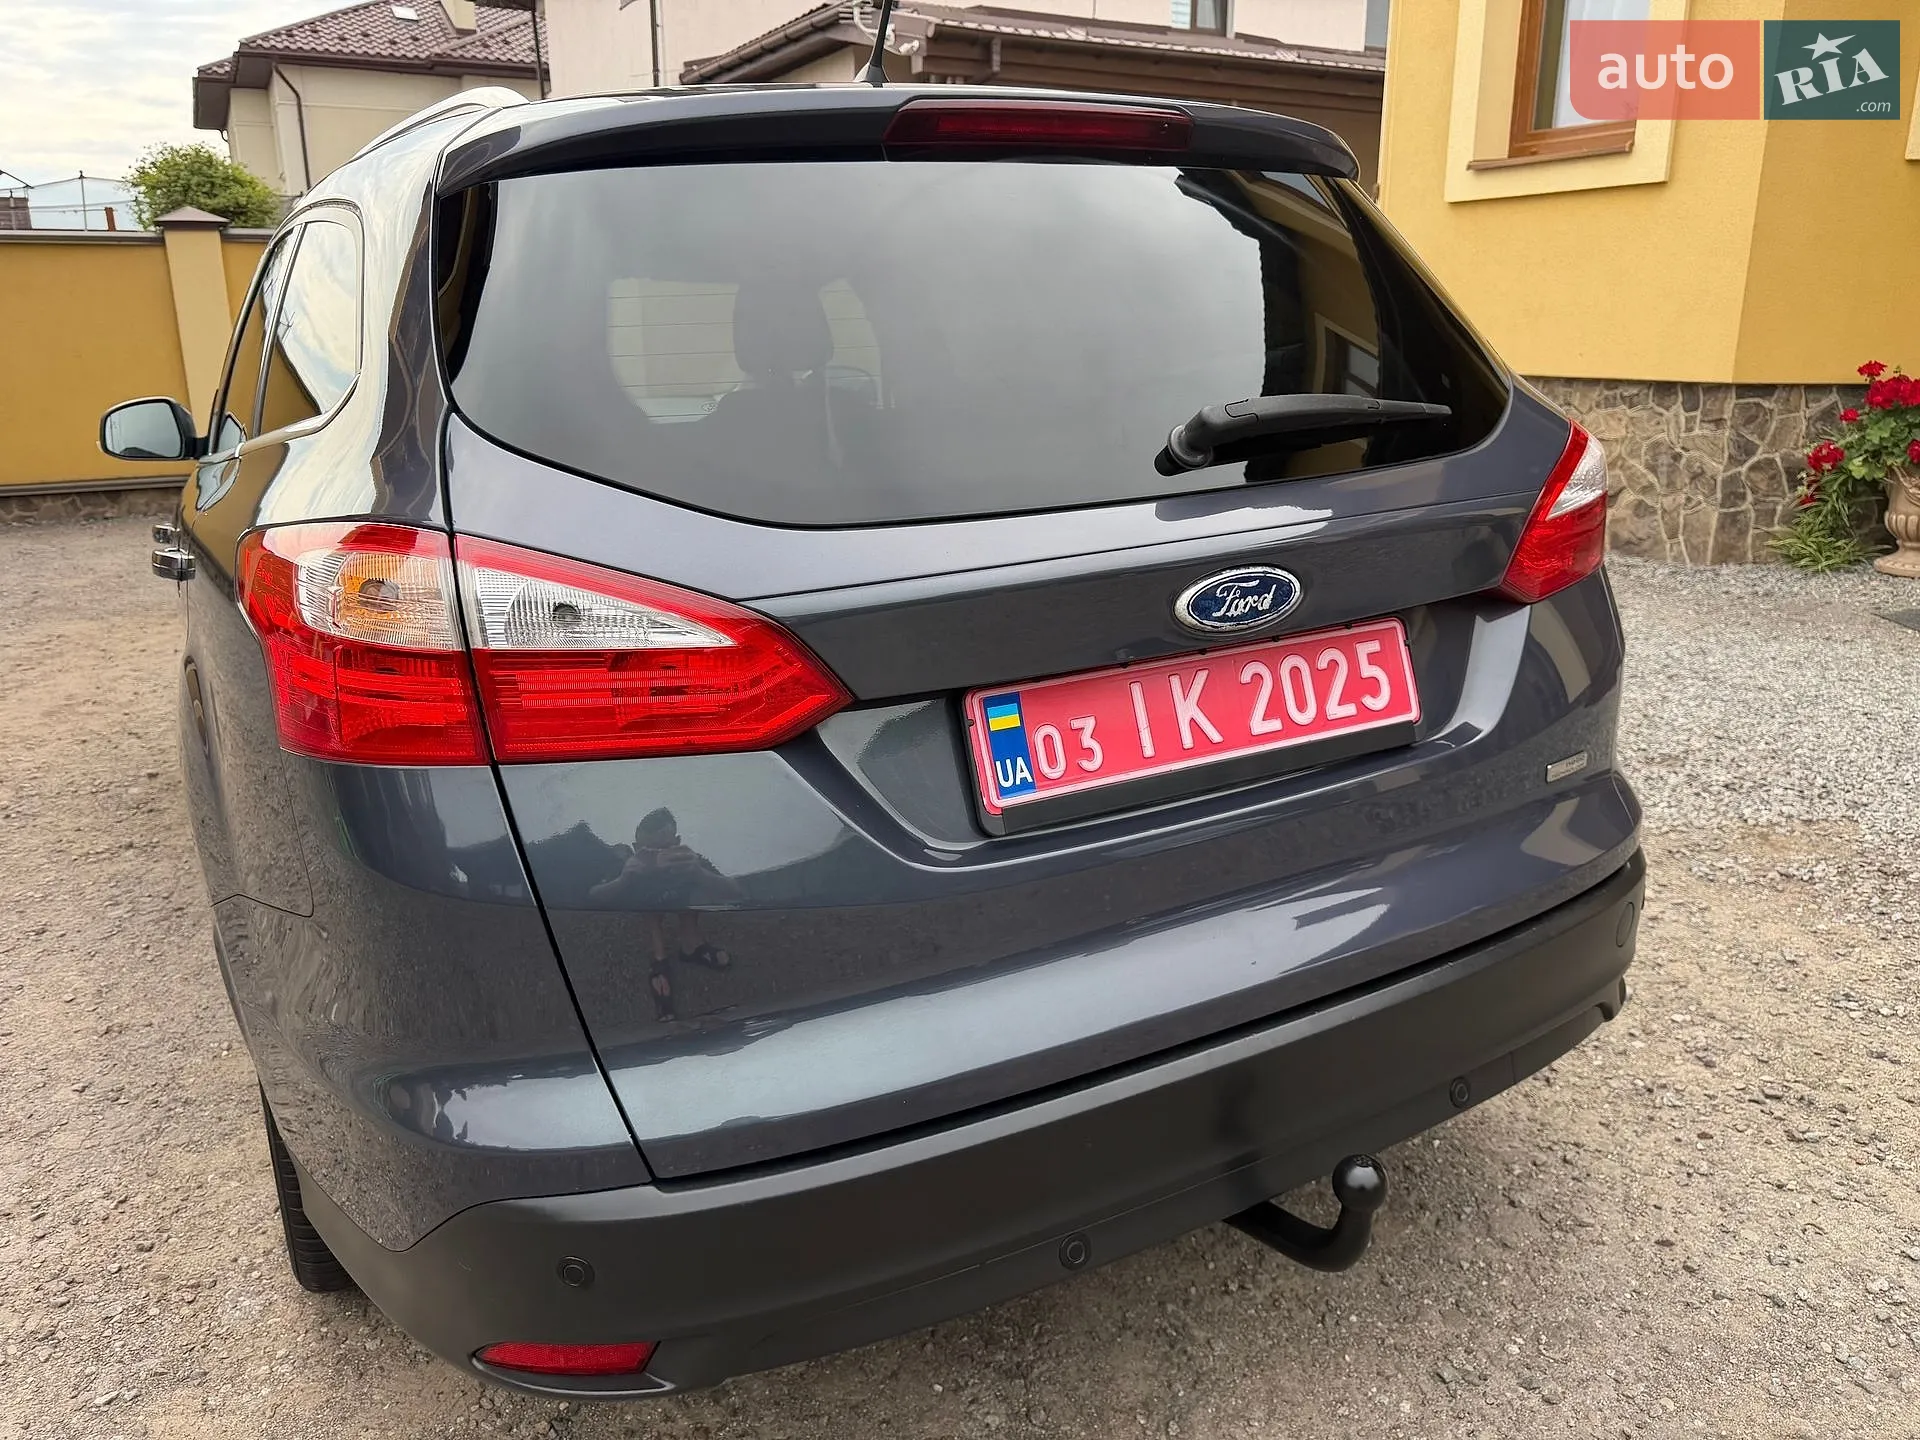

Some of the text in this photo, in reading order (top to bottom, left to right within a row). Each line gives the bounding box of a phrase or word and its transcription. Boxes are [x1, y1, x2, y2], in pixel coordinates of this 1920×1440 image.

[1211, 579, 1277, 618] Ford
[1034, 715, 1104, 780] 03
[1240, 639, 1392, 736] 2025
[995, 756, 1033, 788] UA
